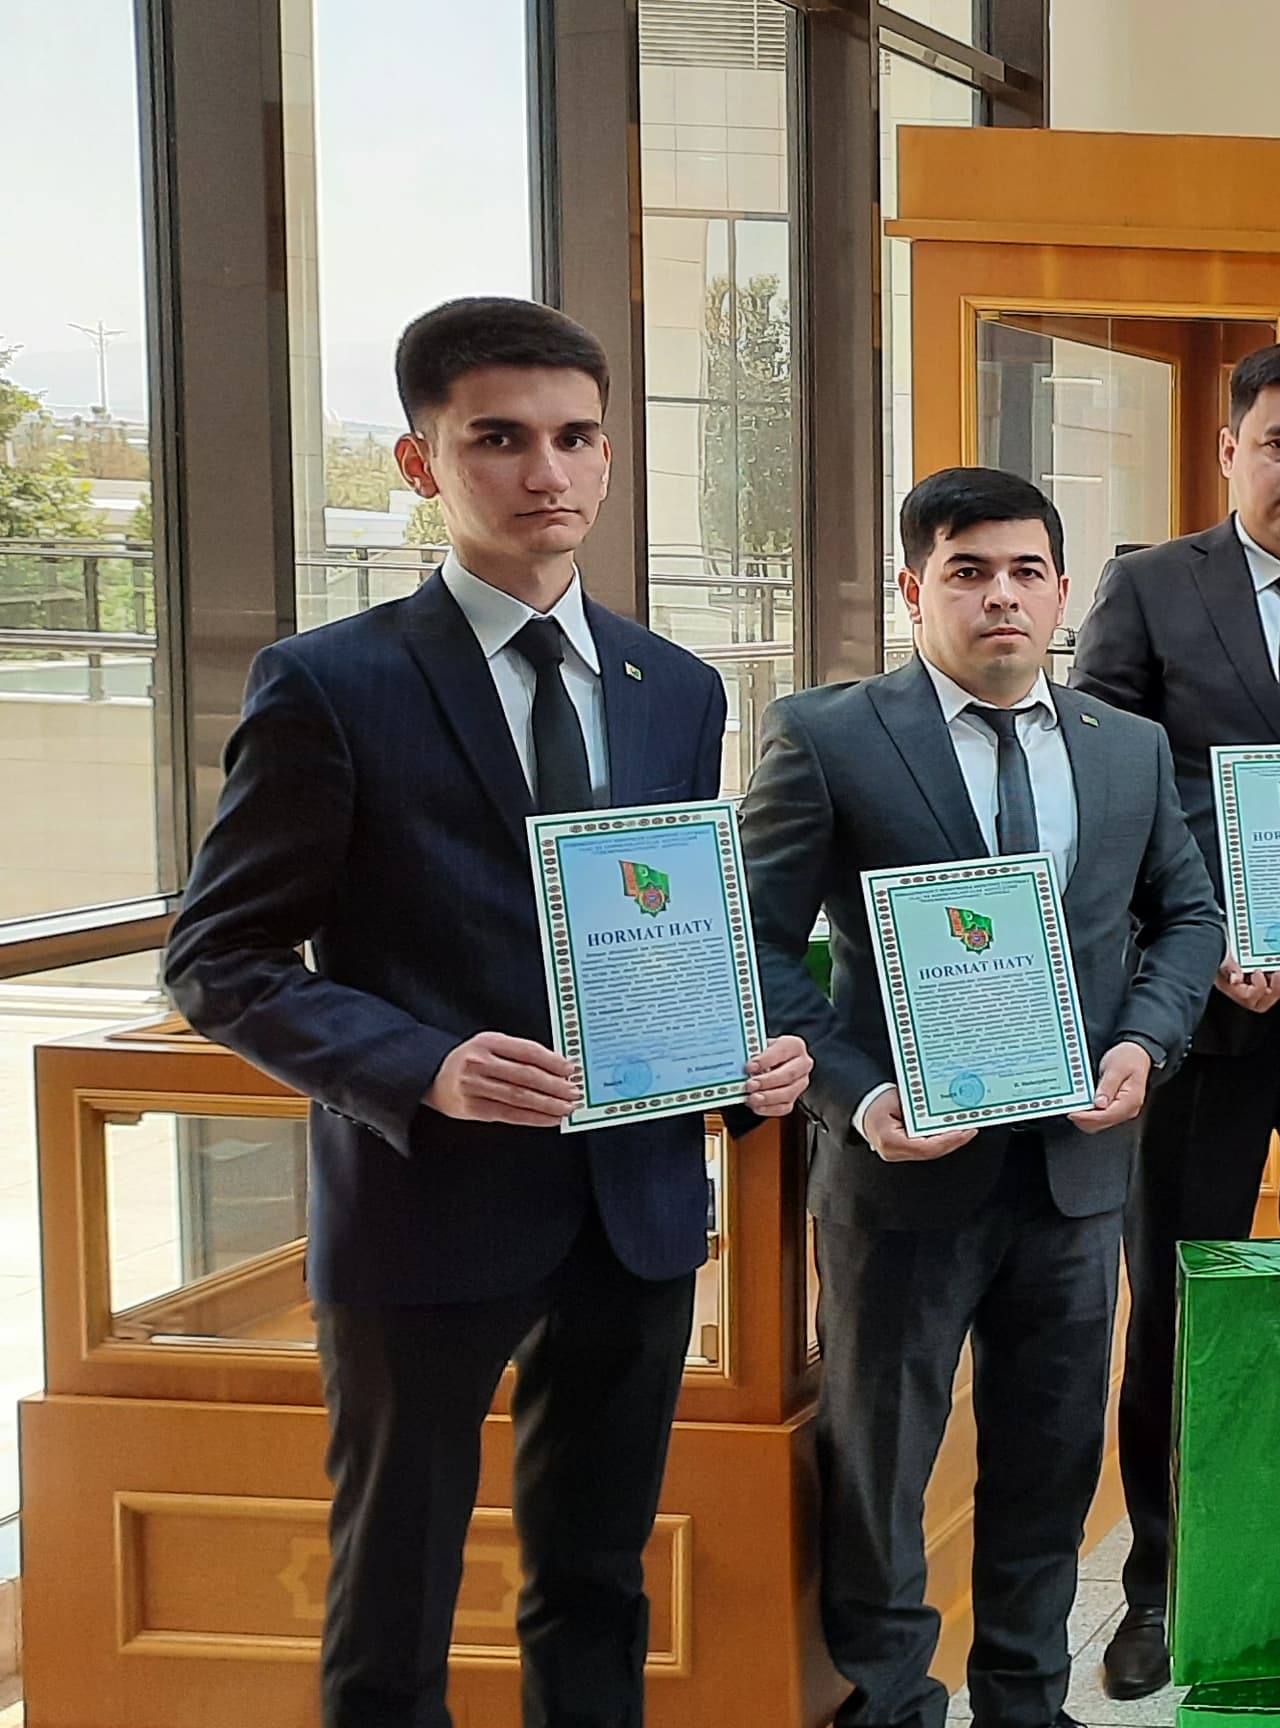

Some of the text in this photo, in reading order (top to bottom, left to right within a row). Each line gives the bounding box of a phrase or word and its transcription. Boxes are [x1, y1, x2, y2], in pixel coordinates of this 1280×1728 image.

[587, 919, 714, 947] HORMAT HATY
[920, 954, 1034, 981] HORMAT HATY
